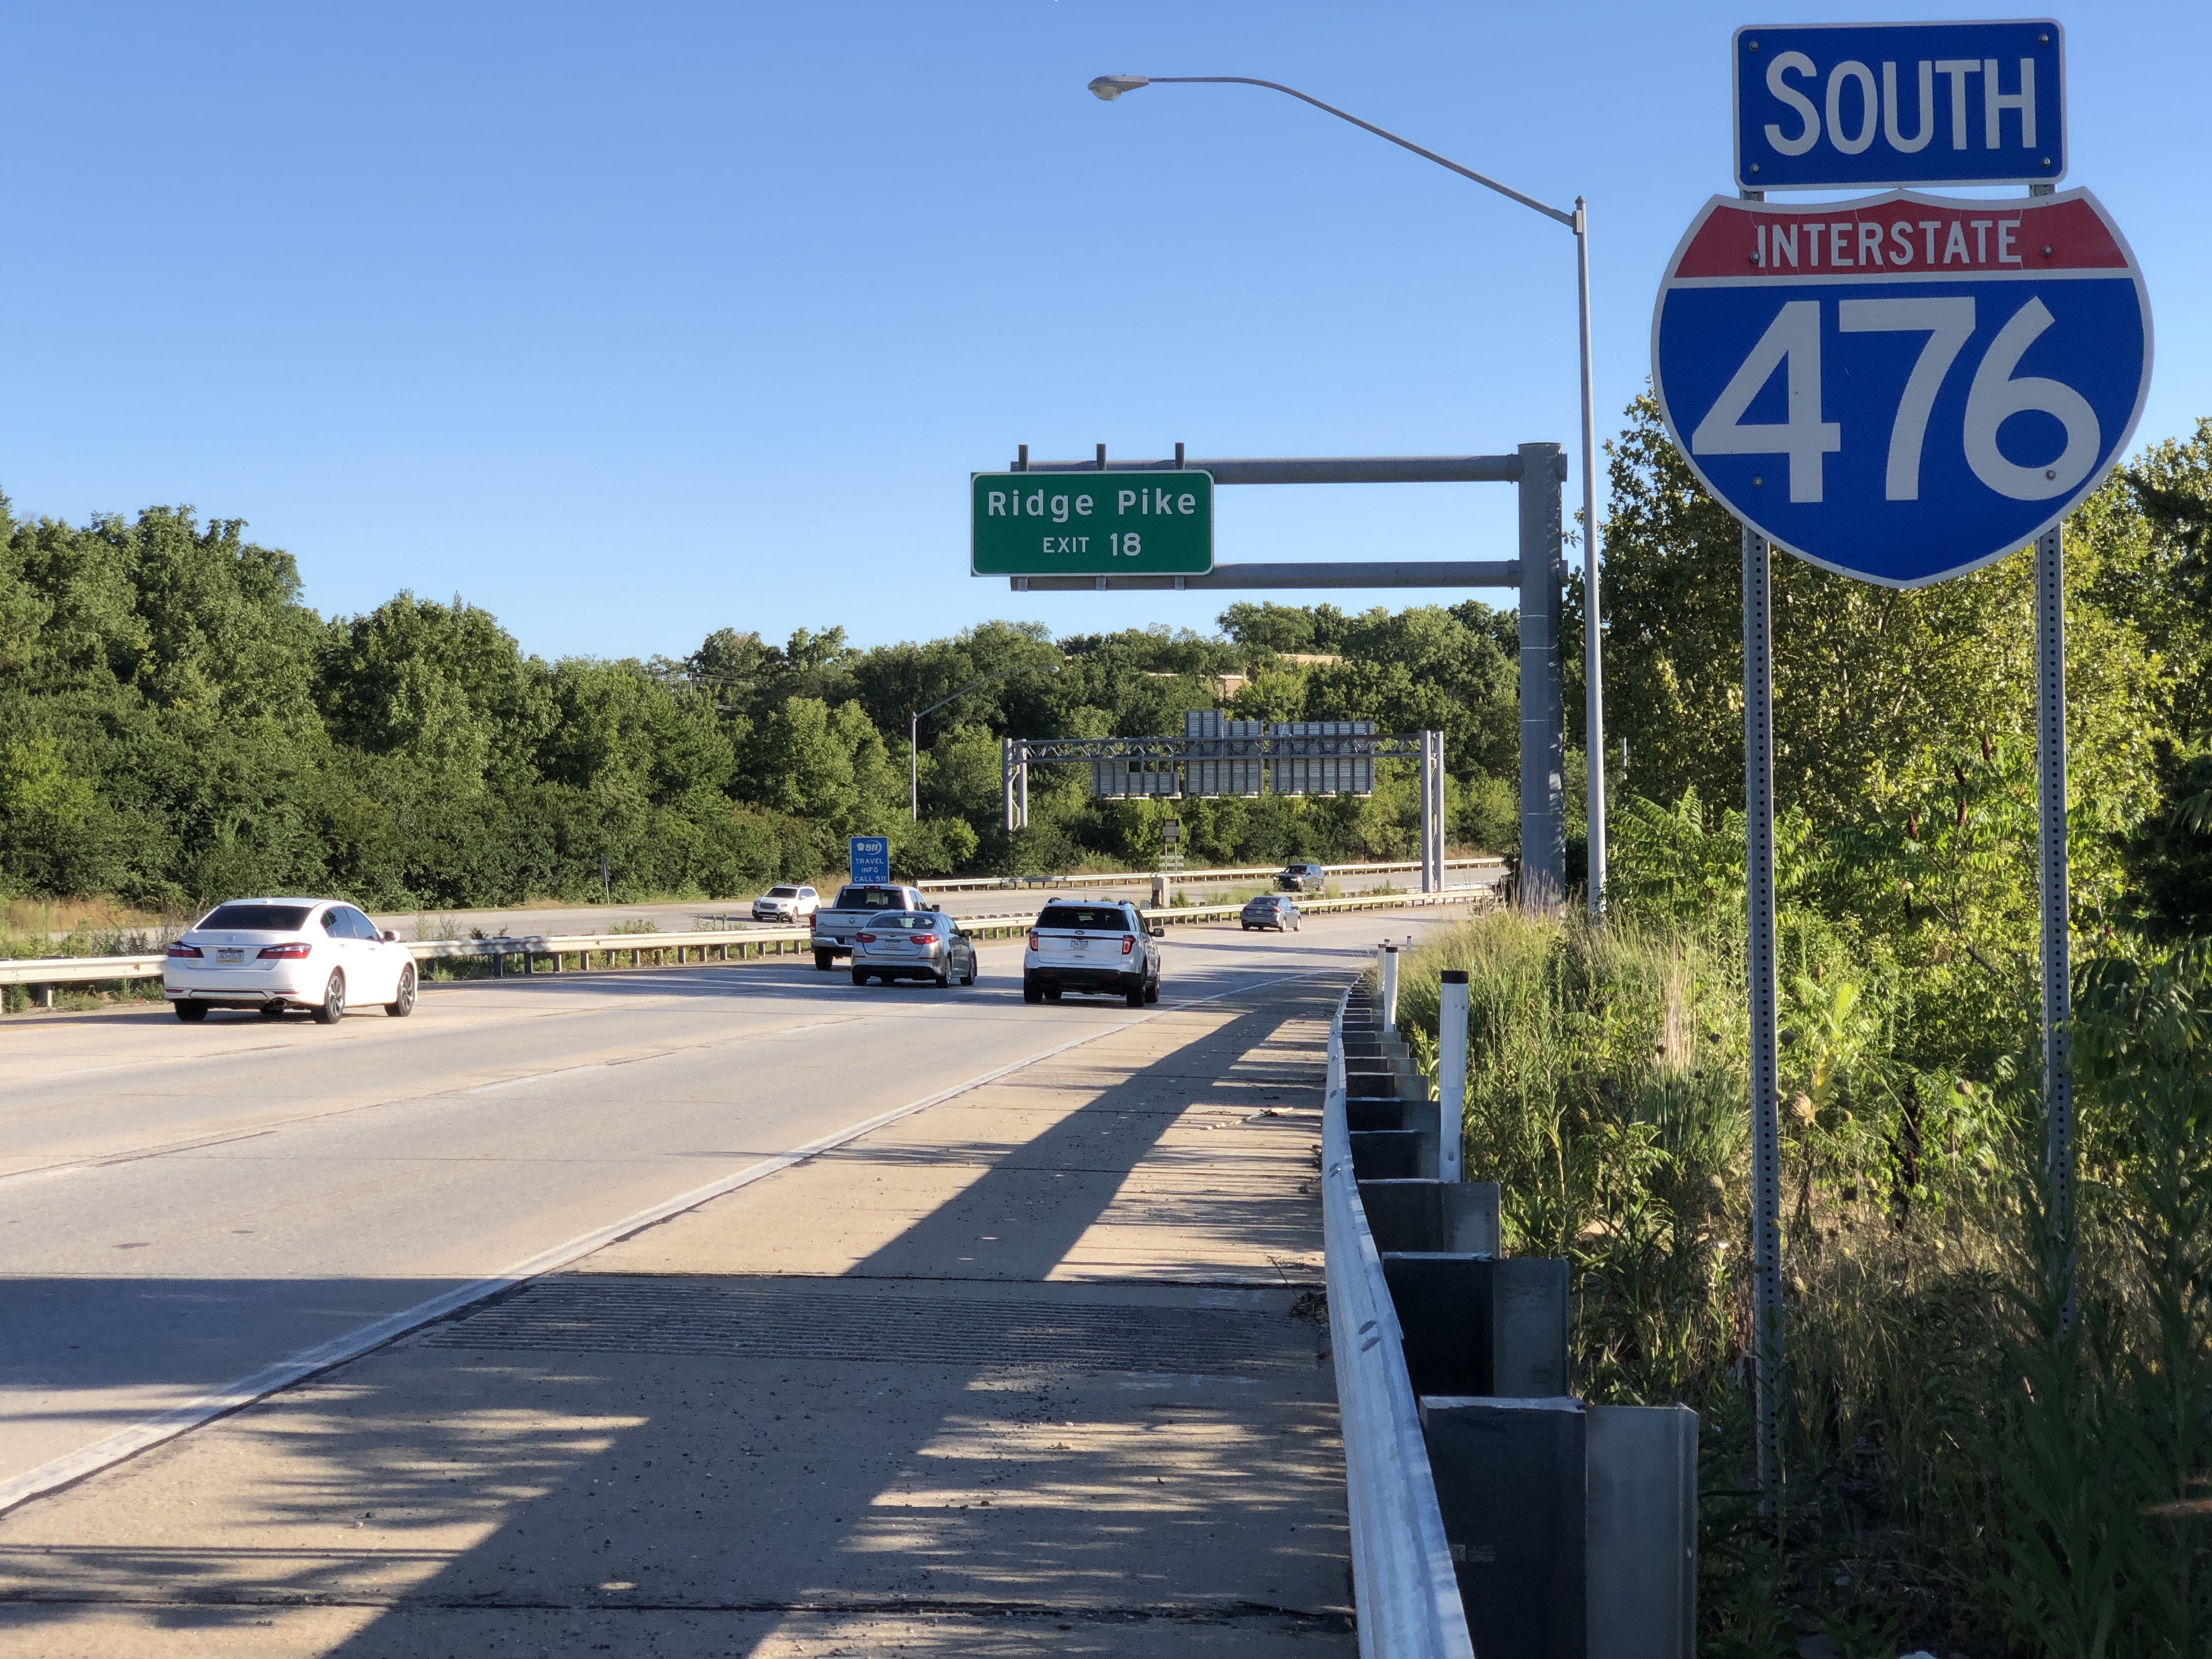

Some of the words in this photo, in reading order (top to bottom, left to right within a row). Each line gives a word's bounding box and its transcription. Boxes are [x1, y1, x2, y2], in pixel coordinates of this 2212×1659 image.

[1763, 51, 2037, 156] SOUTH
[1758, 219, 2023, 268] INTERSTATE
[1691, 296, 2101, 503] 476
[988, 489, 1093, 523] Ridge
[1118, 488, 1196, 515] Pike
[1043, 537, 1090, 554] EXIT
[1110, 532, 1141, 556] 18
